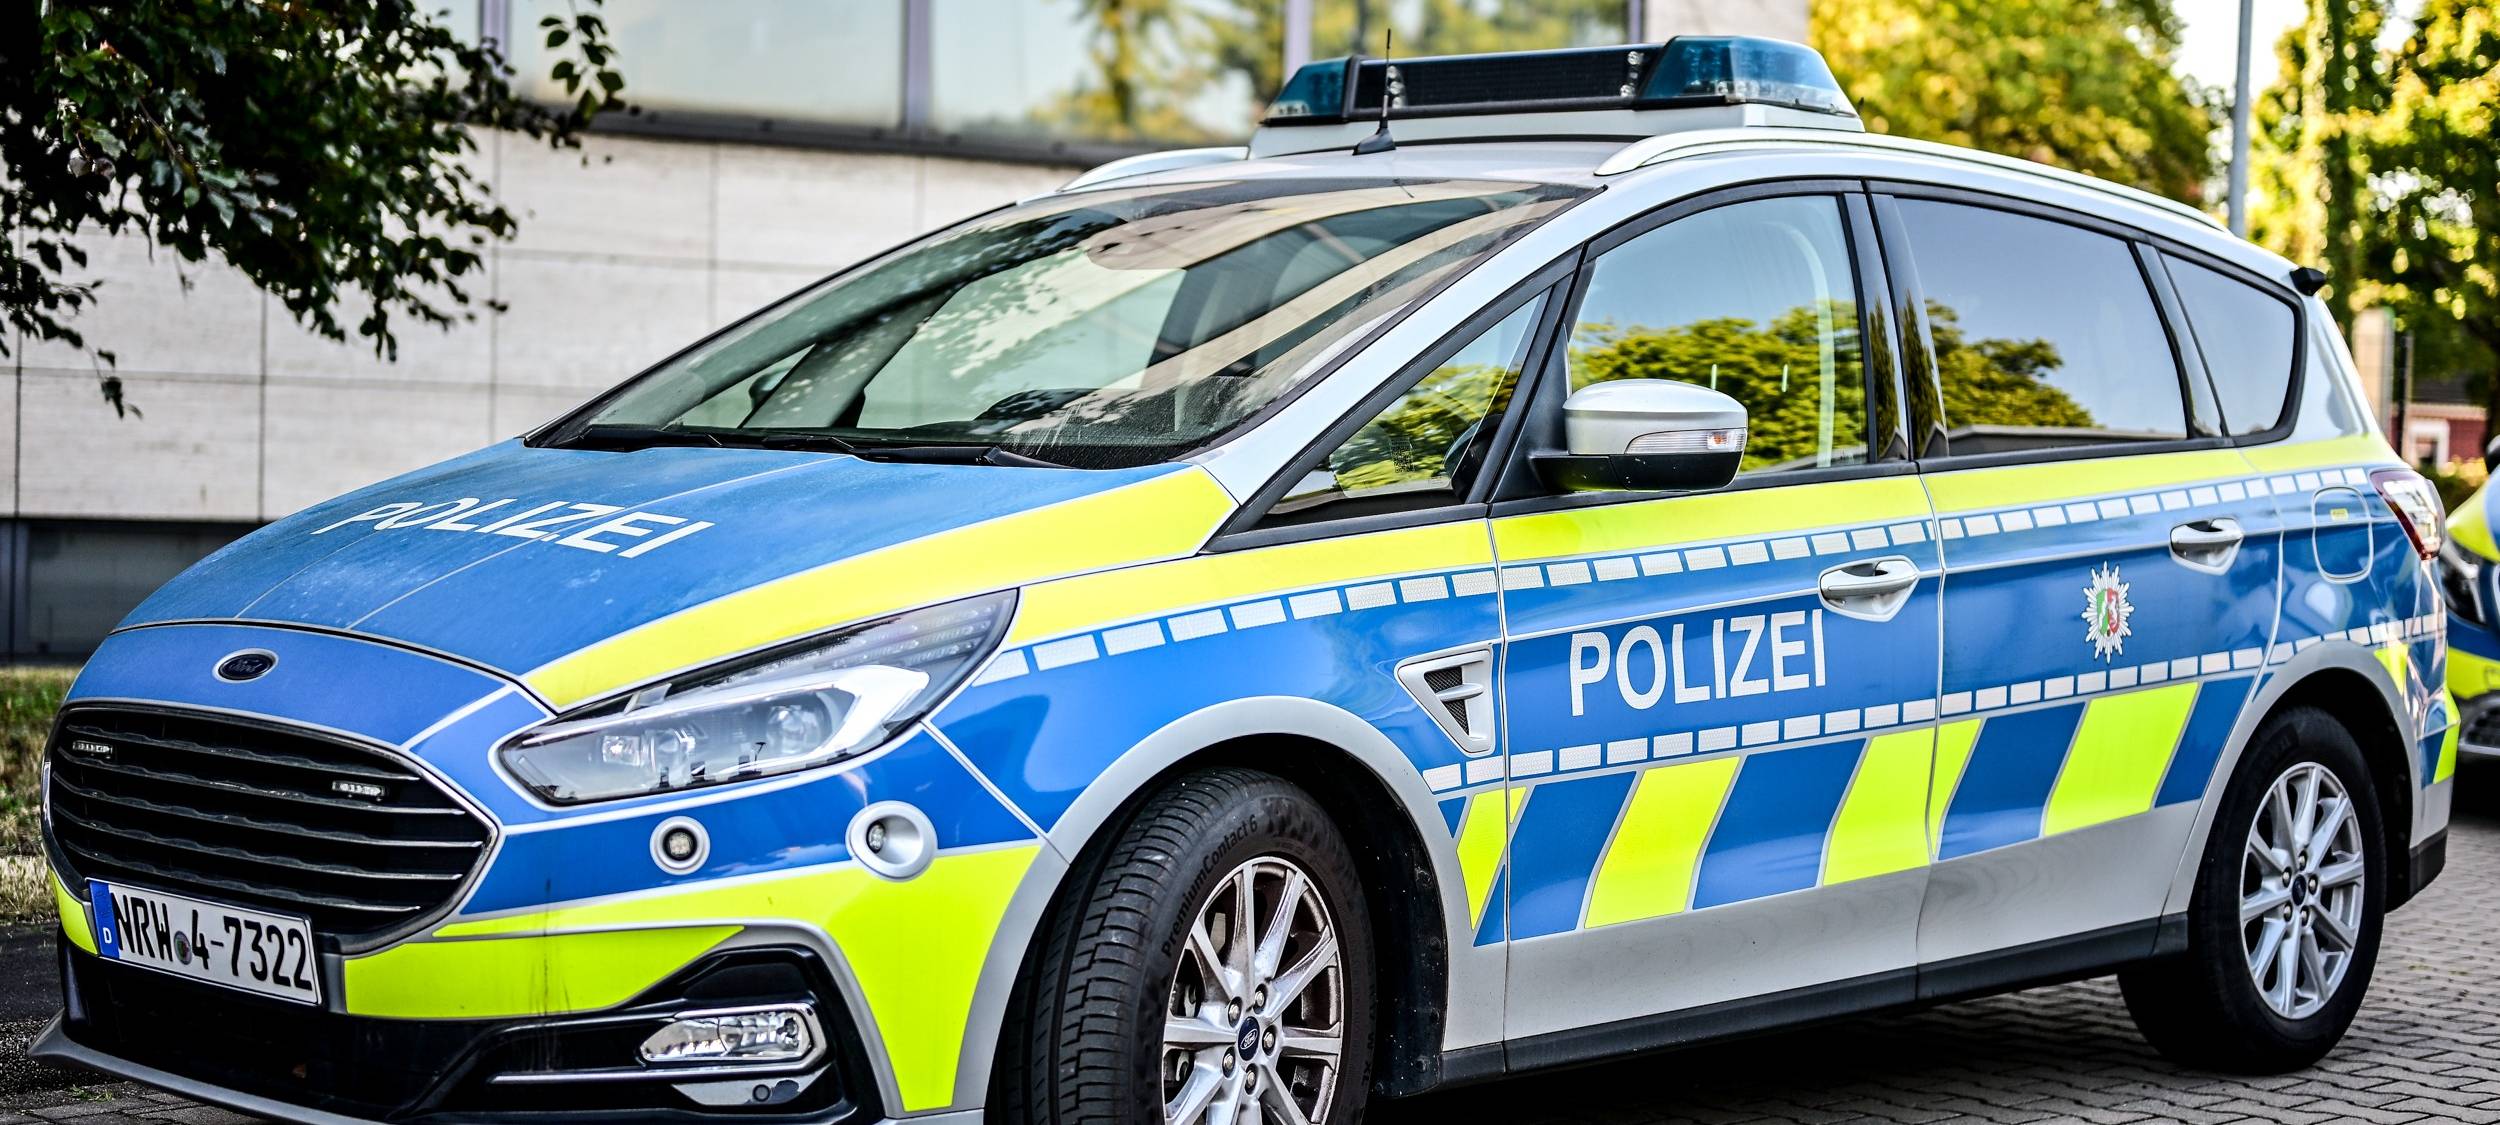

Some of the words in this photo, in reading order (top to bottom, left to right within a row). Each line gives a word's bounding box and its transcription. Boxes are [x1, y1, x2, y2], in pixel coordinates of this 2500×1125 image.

[310, 497, 715, 559] POLIZEI
[1569, 608, 1826, 717] POLIZEI
[102, 927, 113, 944] D
[1160, 822, 1250, 958] PremiumContact
[1249, 814, 1259, 833] 6
[110, 892, 174, 963] NRW
[191, 909, 313, 991] 4-7322
